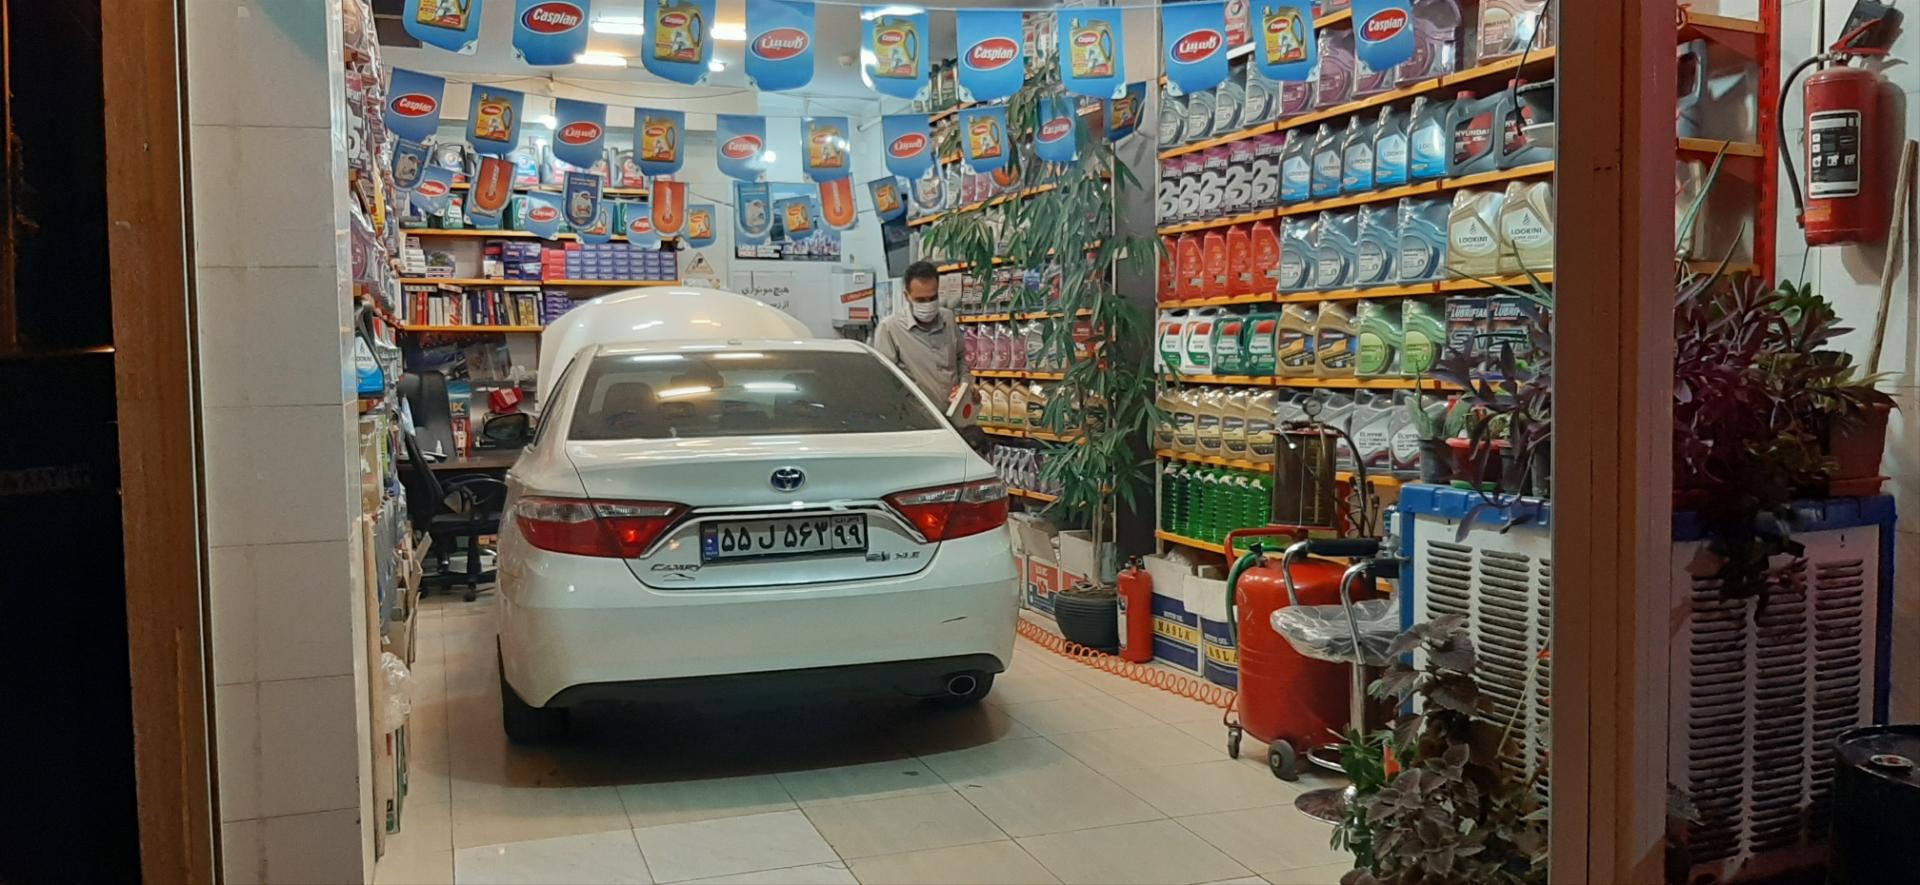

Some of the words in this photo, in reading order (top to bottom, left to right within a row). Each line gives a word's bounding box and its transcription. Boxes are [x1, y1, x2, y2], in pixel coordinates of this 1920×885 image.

[532, 8, 578, 26] Caspian
[1367, 13, 1403, 32] Caspian
[973, 45, 1014, 61] Caspian
[399, 98, 433, 112] Caspian
